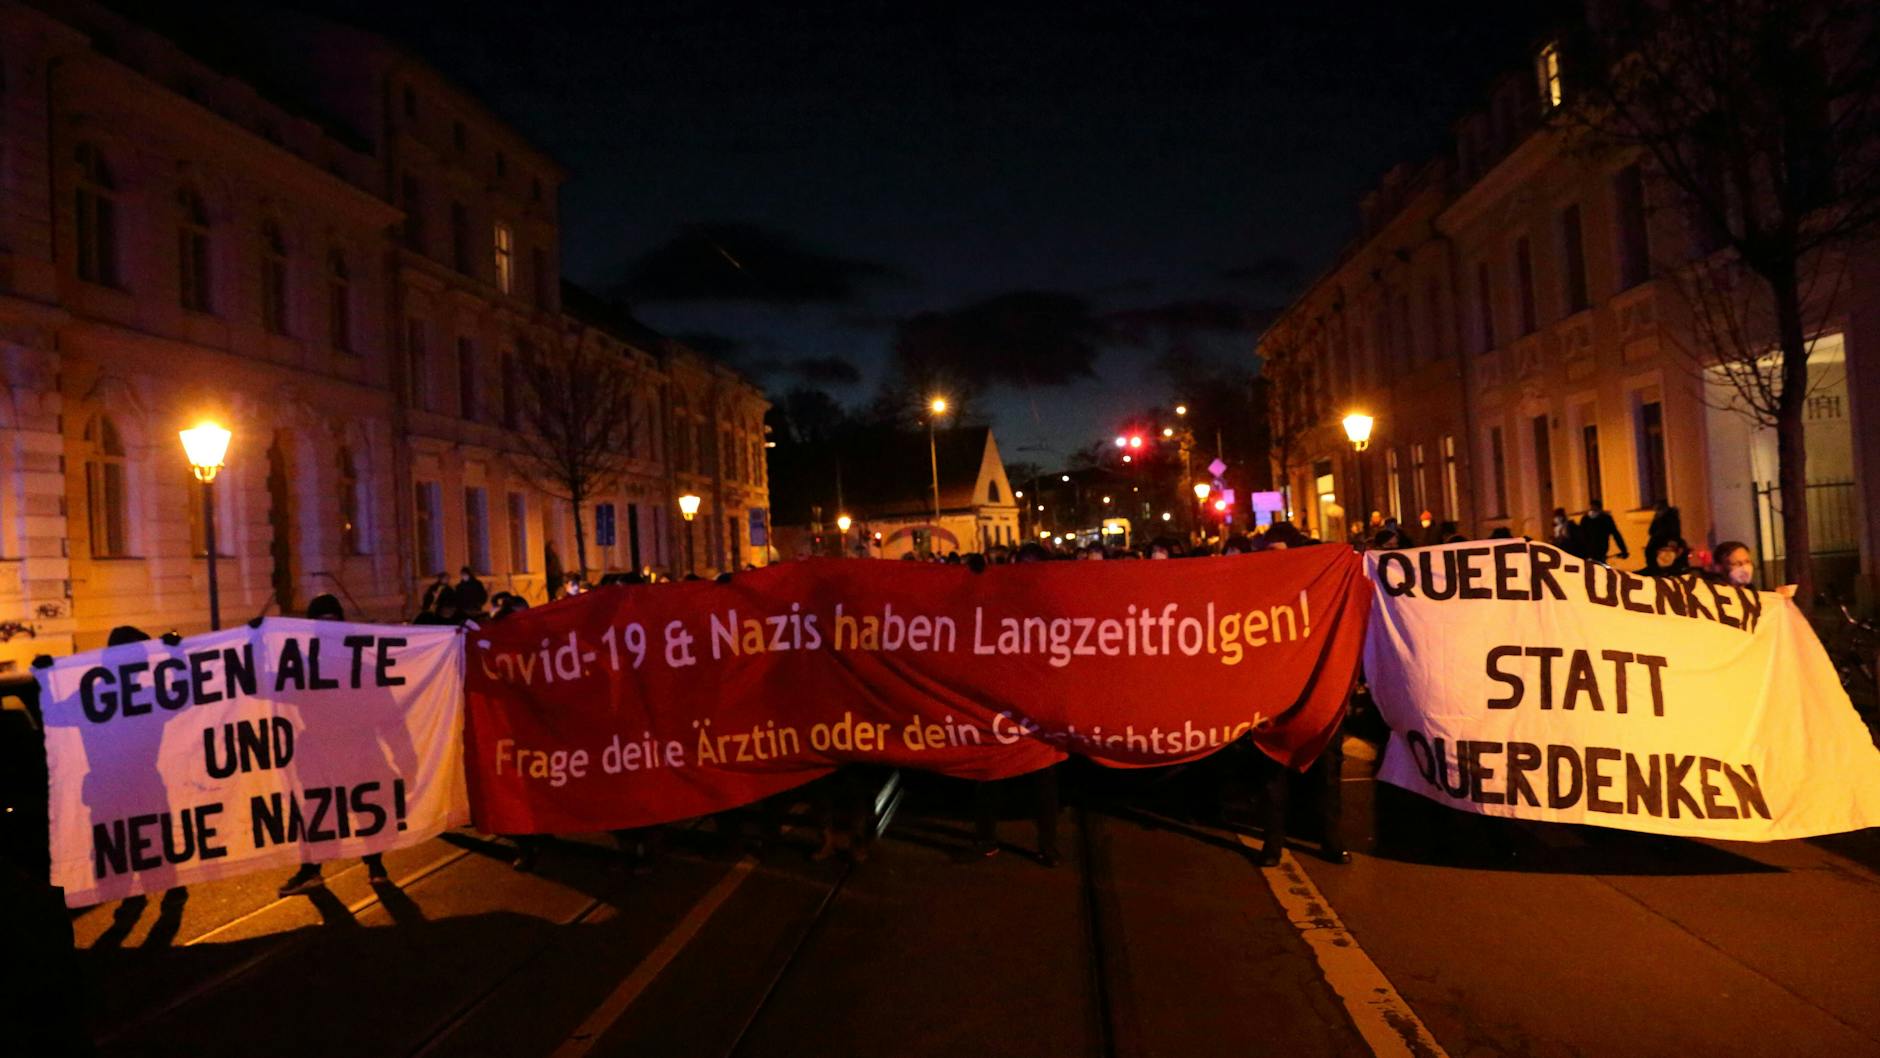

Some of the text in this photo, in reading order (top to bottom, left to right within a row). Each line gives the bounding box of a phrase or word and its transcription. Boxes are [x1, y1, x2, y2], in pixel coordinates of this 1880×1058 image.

[665, 620, 696, 668] &
[711, 603, 821, 660] Nazis
[835, 603, 956, 652] haben
[973, 590, 1311, 667] Langzeitfolgen!
[1378, 543, 1763, 634] QUEER-DENKEN
[80, 635, 407, 723] GEGEN ALTE
[1486, 645, 1668, 717] STATT
[204, 716, 293, 778] UND
[496, 739, 588, 787] Frage
[692, 717, 799, 766] Ärztin
[810, 711, 890, 752] oder
[903, 714, 980, 751] dein
[1406, 730, 1773, 820] QUERDENKEN
[93, 779, 407, 880] NEUE NAZIS!
